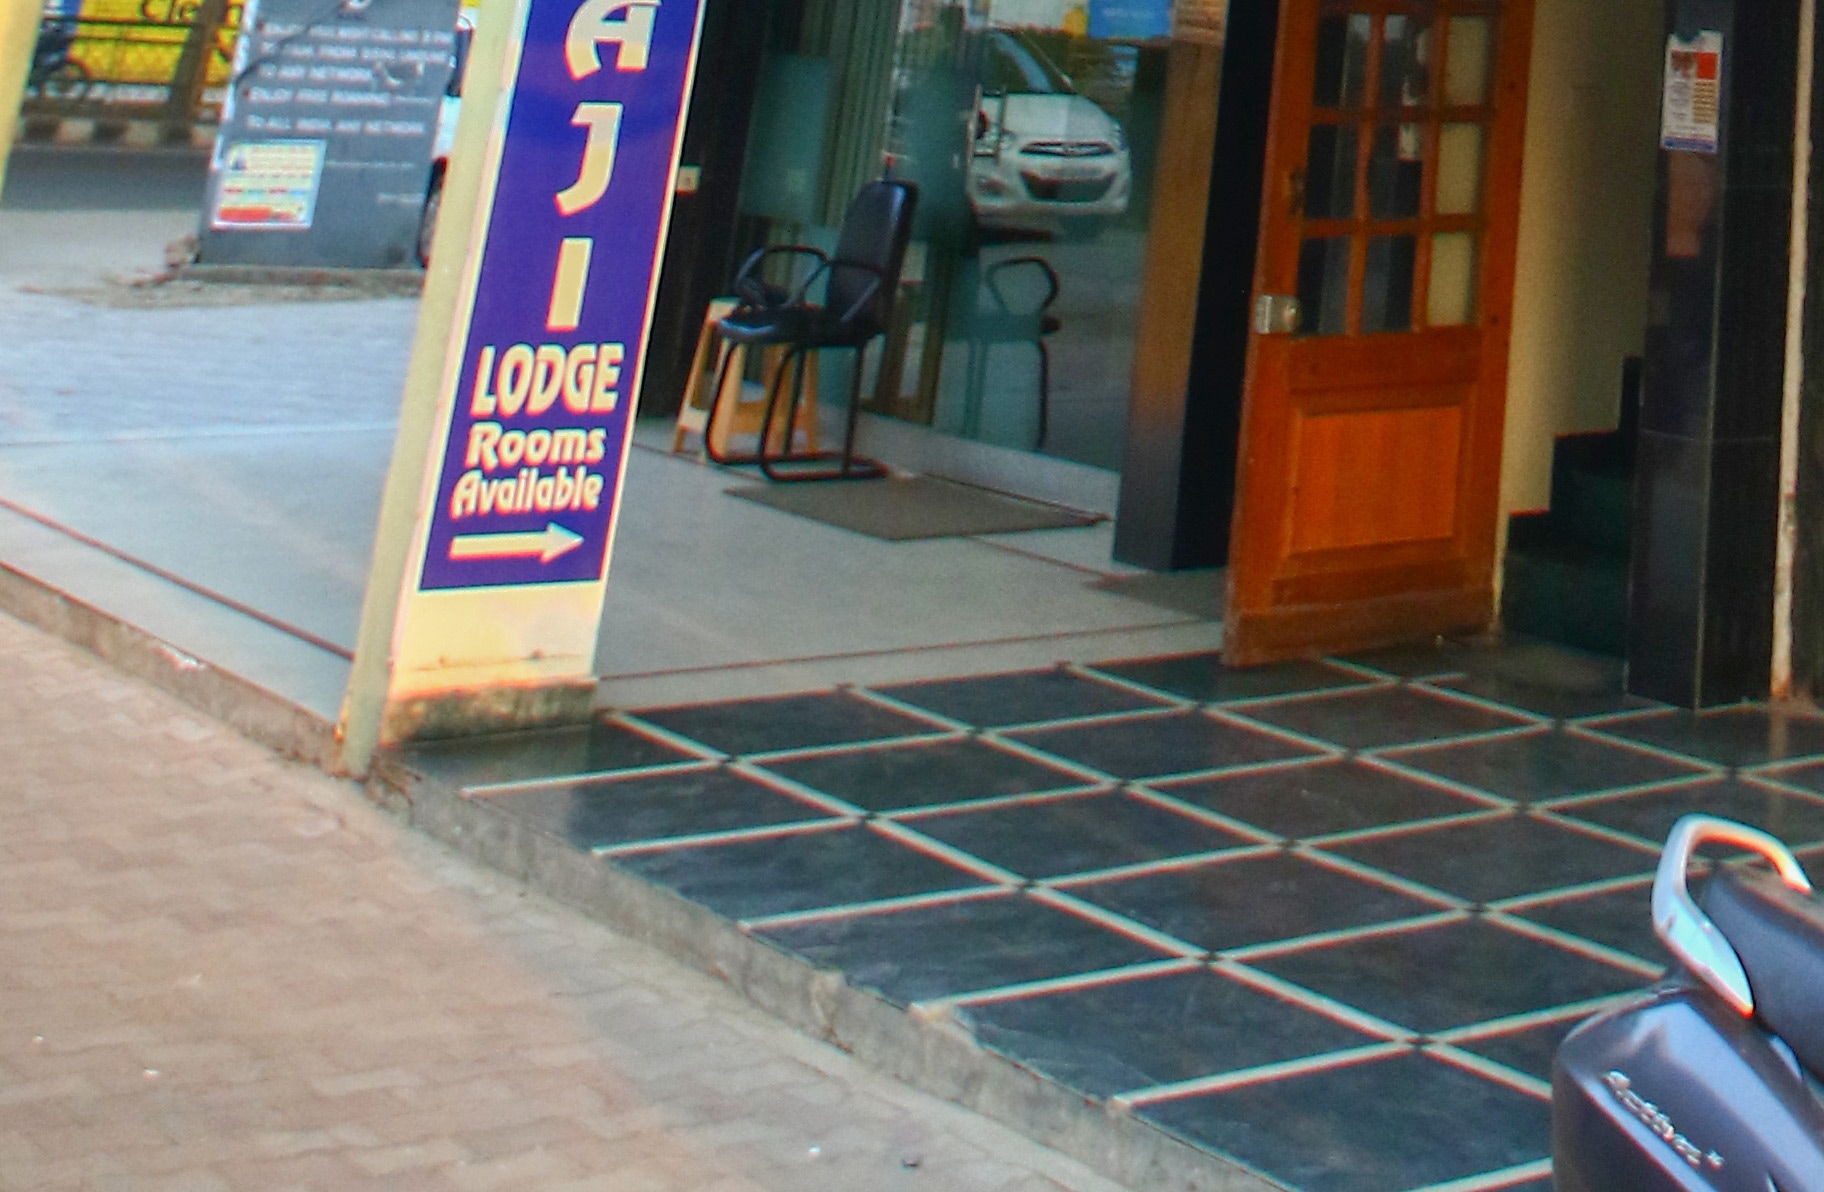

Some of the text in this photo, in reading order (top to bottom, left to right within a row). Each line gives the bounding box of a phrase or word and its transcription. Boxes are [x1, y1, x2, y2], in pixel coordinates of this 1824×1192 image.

[470, 343, 625, 416] LODGE
[465, 421, 606, 471] Rooms
[450, 468, 604, 519] Available
